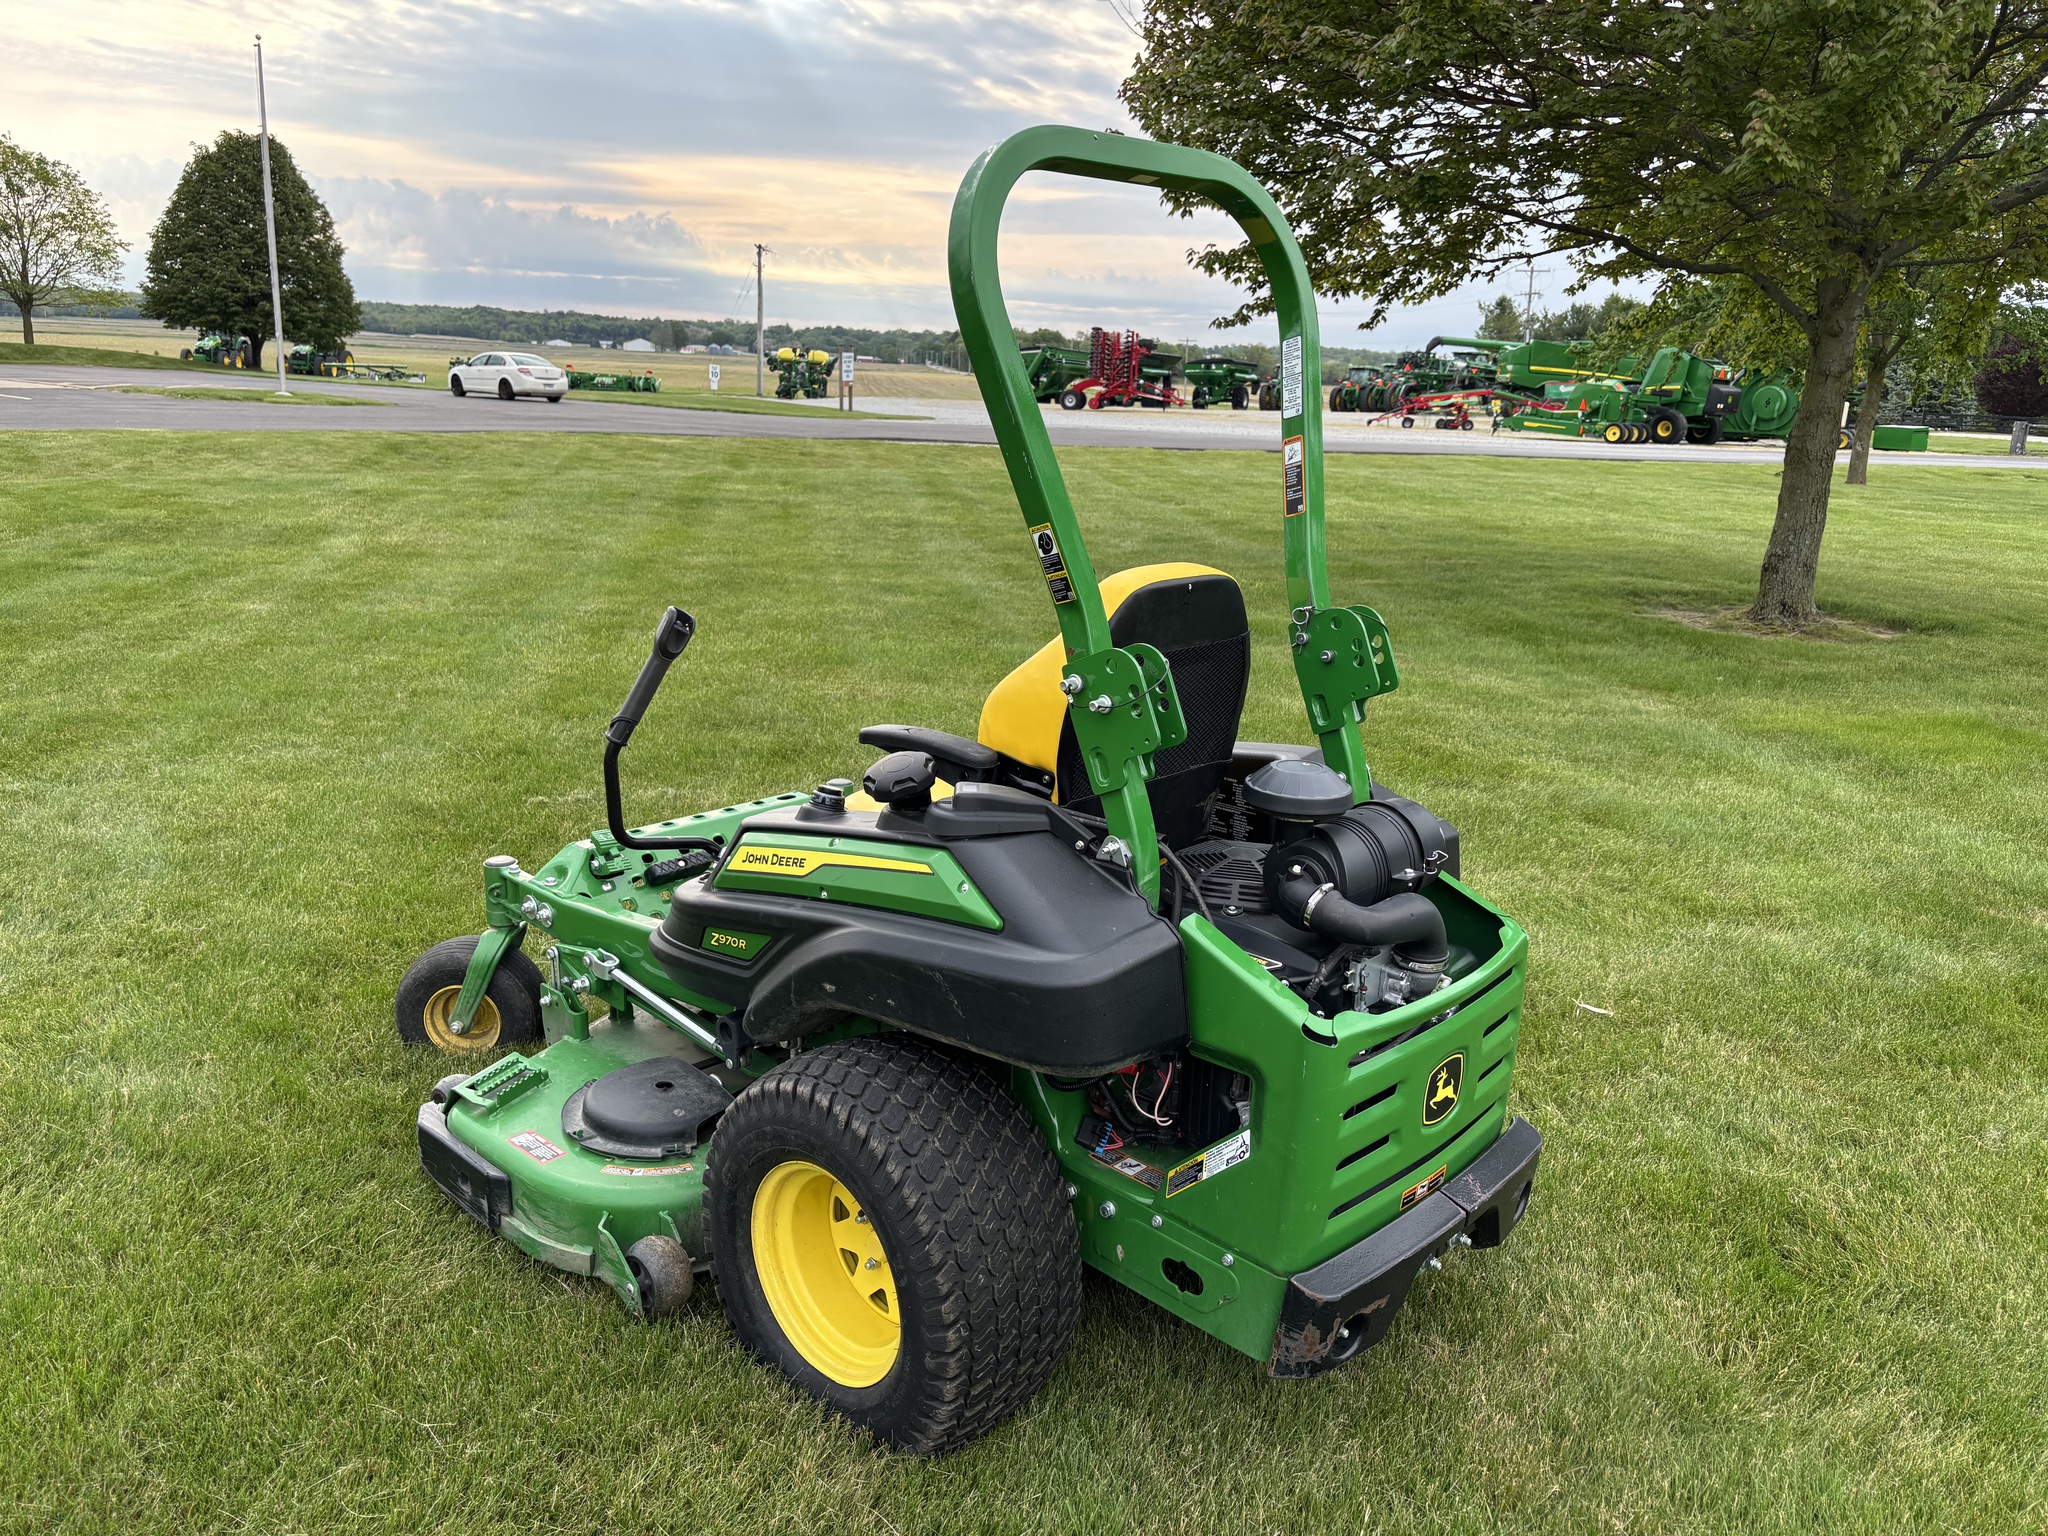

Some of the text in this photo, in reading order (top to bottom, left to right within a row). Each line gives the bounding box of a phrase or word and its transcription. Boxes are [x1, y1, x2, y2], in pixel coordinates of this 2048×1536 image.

[742, 851, 806, 868] JOHN DEERE
[710, 932, 747, 950] Z970R
